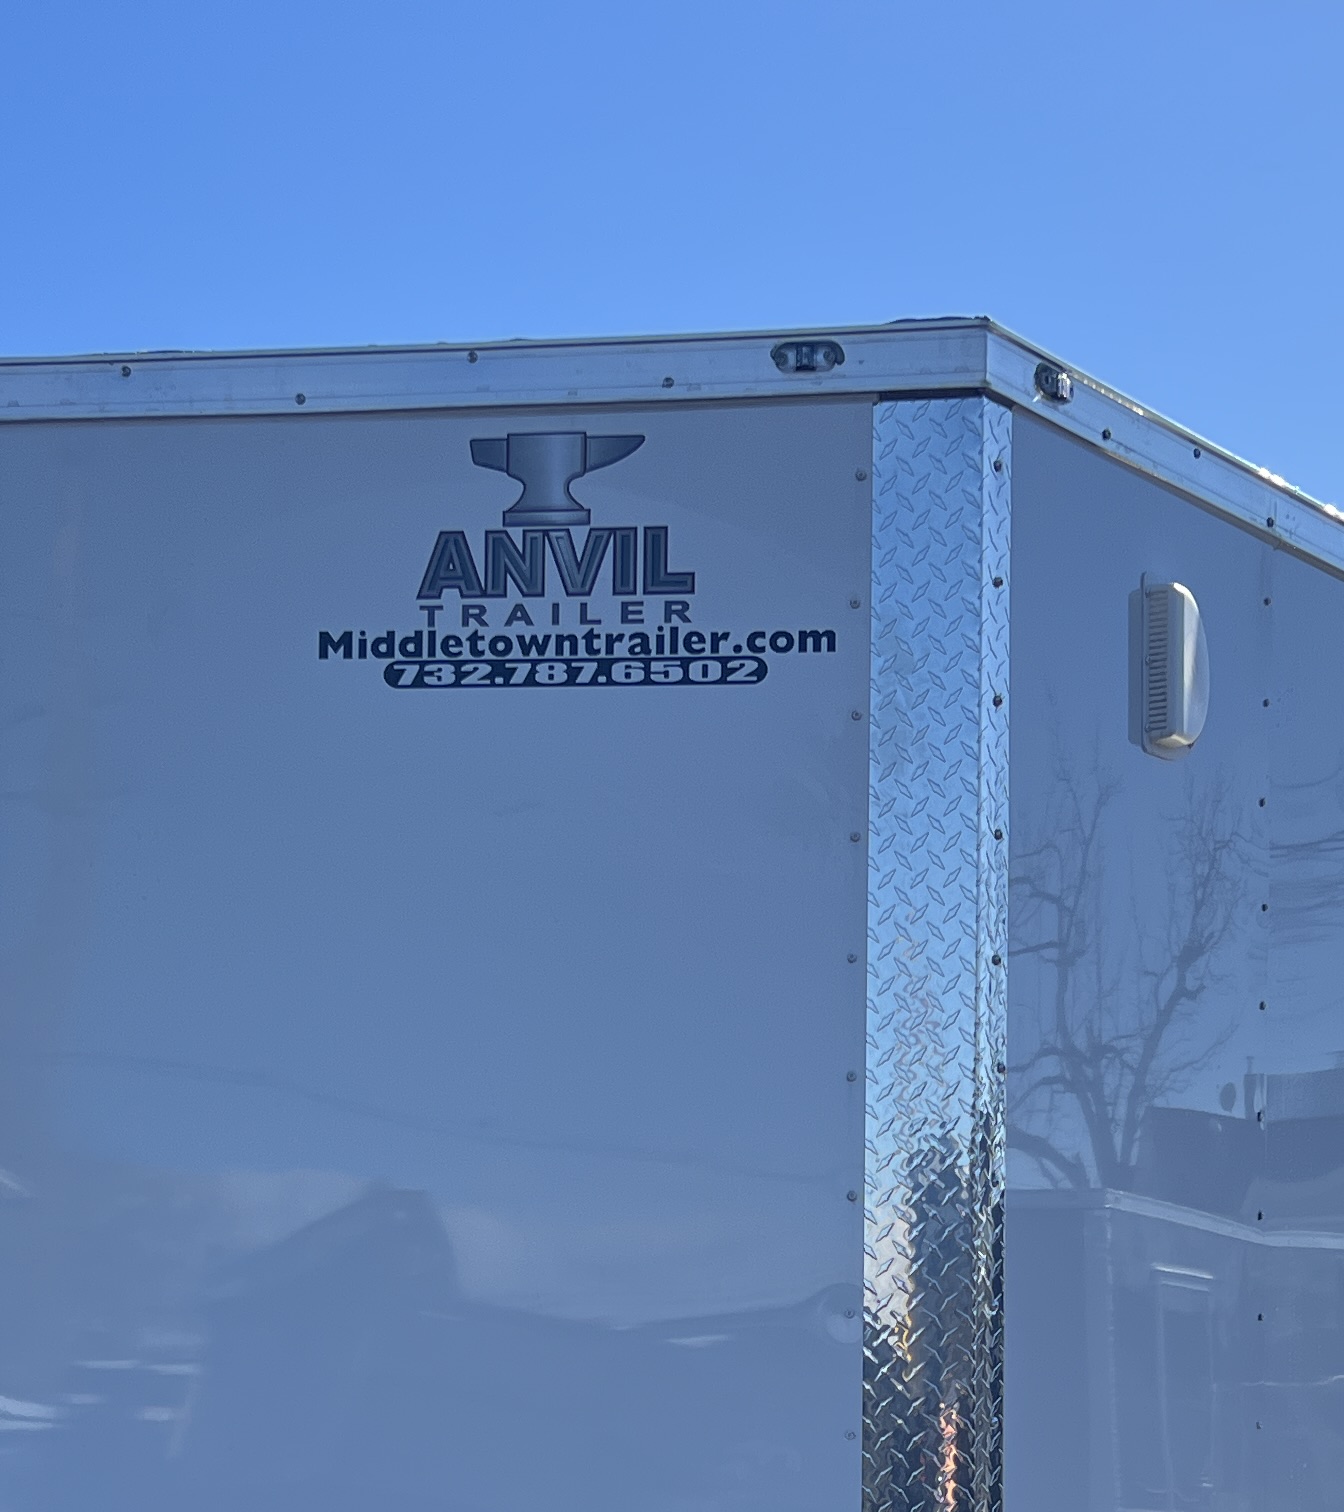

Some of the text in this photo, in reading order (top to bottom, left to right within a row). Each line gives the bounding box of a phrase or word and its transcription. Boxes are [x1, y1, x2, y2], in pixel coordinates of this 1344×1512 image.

[416, 526, 695, 599] ANVIL
[419, 600, 692, 627] TRAILER
[318, 626, 836, 660] Middletowntrailer.com
[392, 660, 759, 686] 732.787.6502
